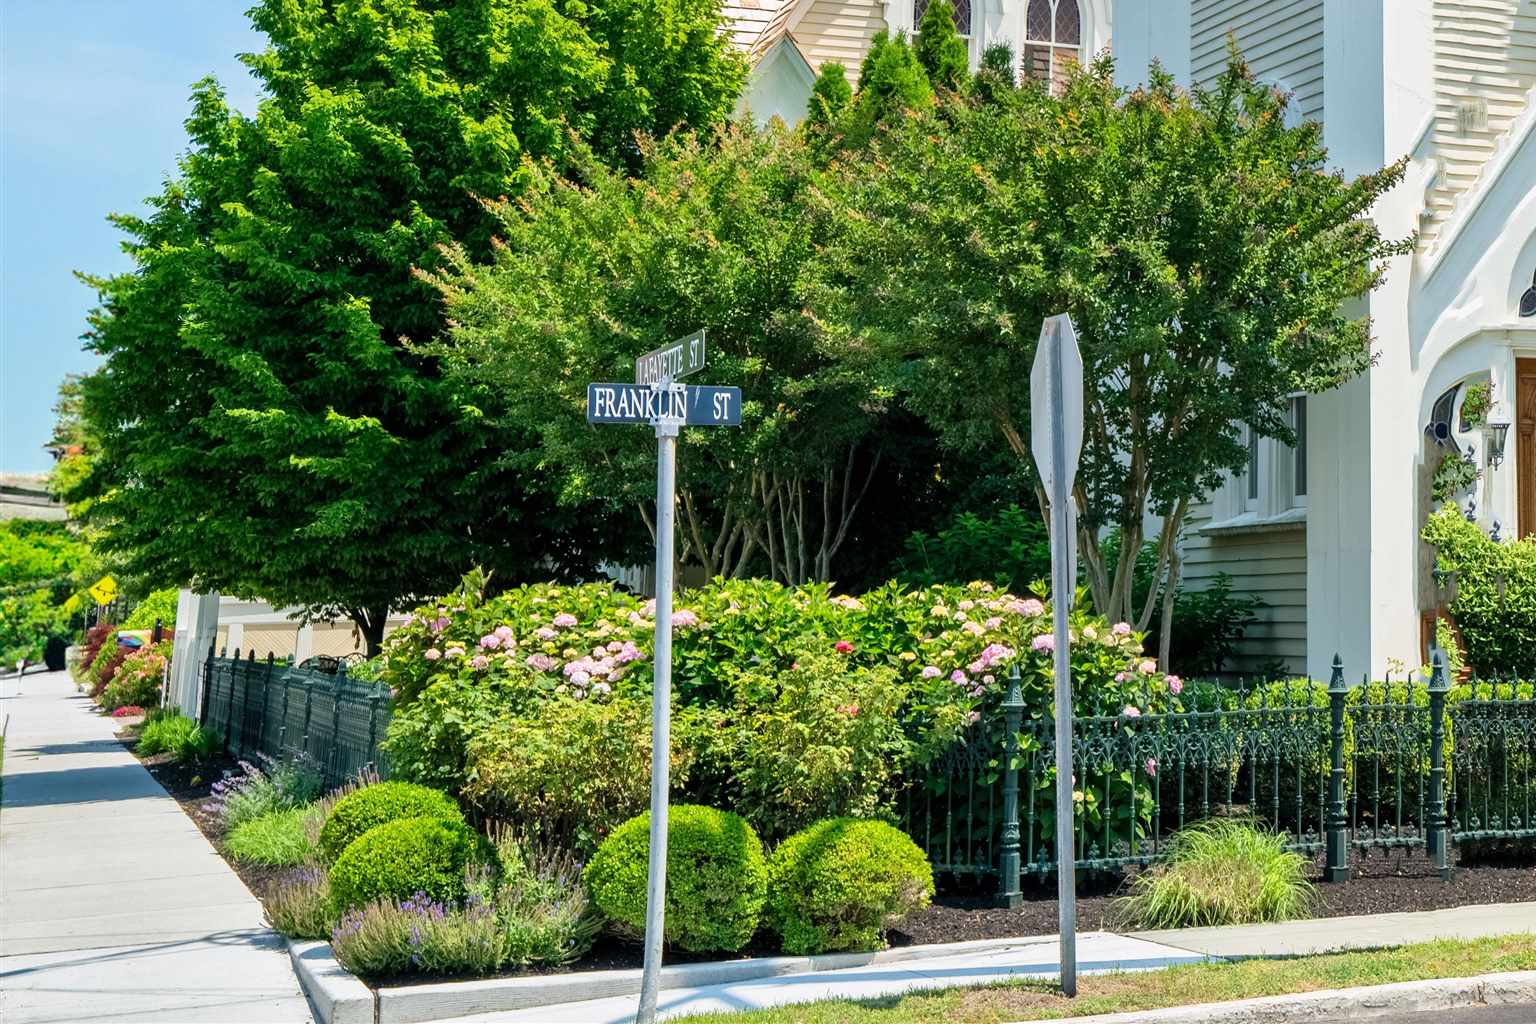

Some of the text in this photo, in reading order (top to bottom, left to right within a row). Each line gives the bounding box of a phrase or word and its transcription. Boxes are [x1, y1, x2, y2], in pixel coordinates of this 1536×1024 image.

[639, 339, 700, 385] LAFAYETTE ST
[594, 387, 731, 420] FRANKLIN ST
